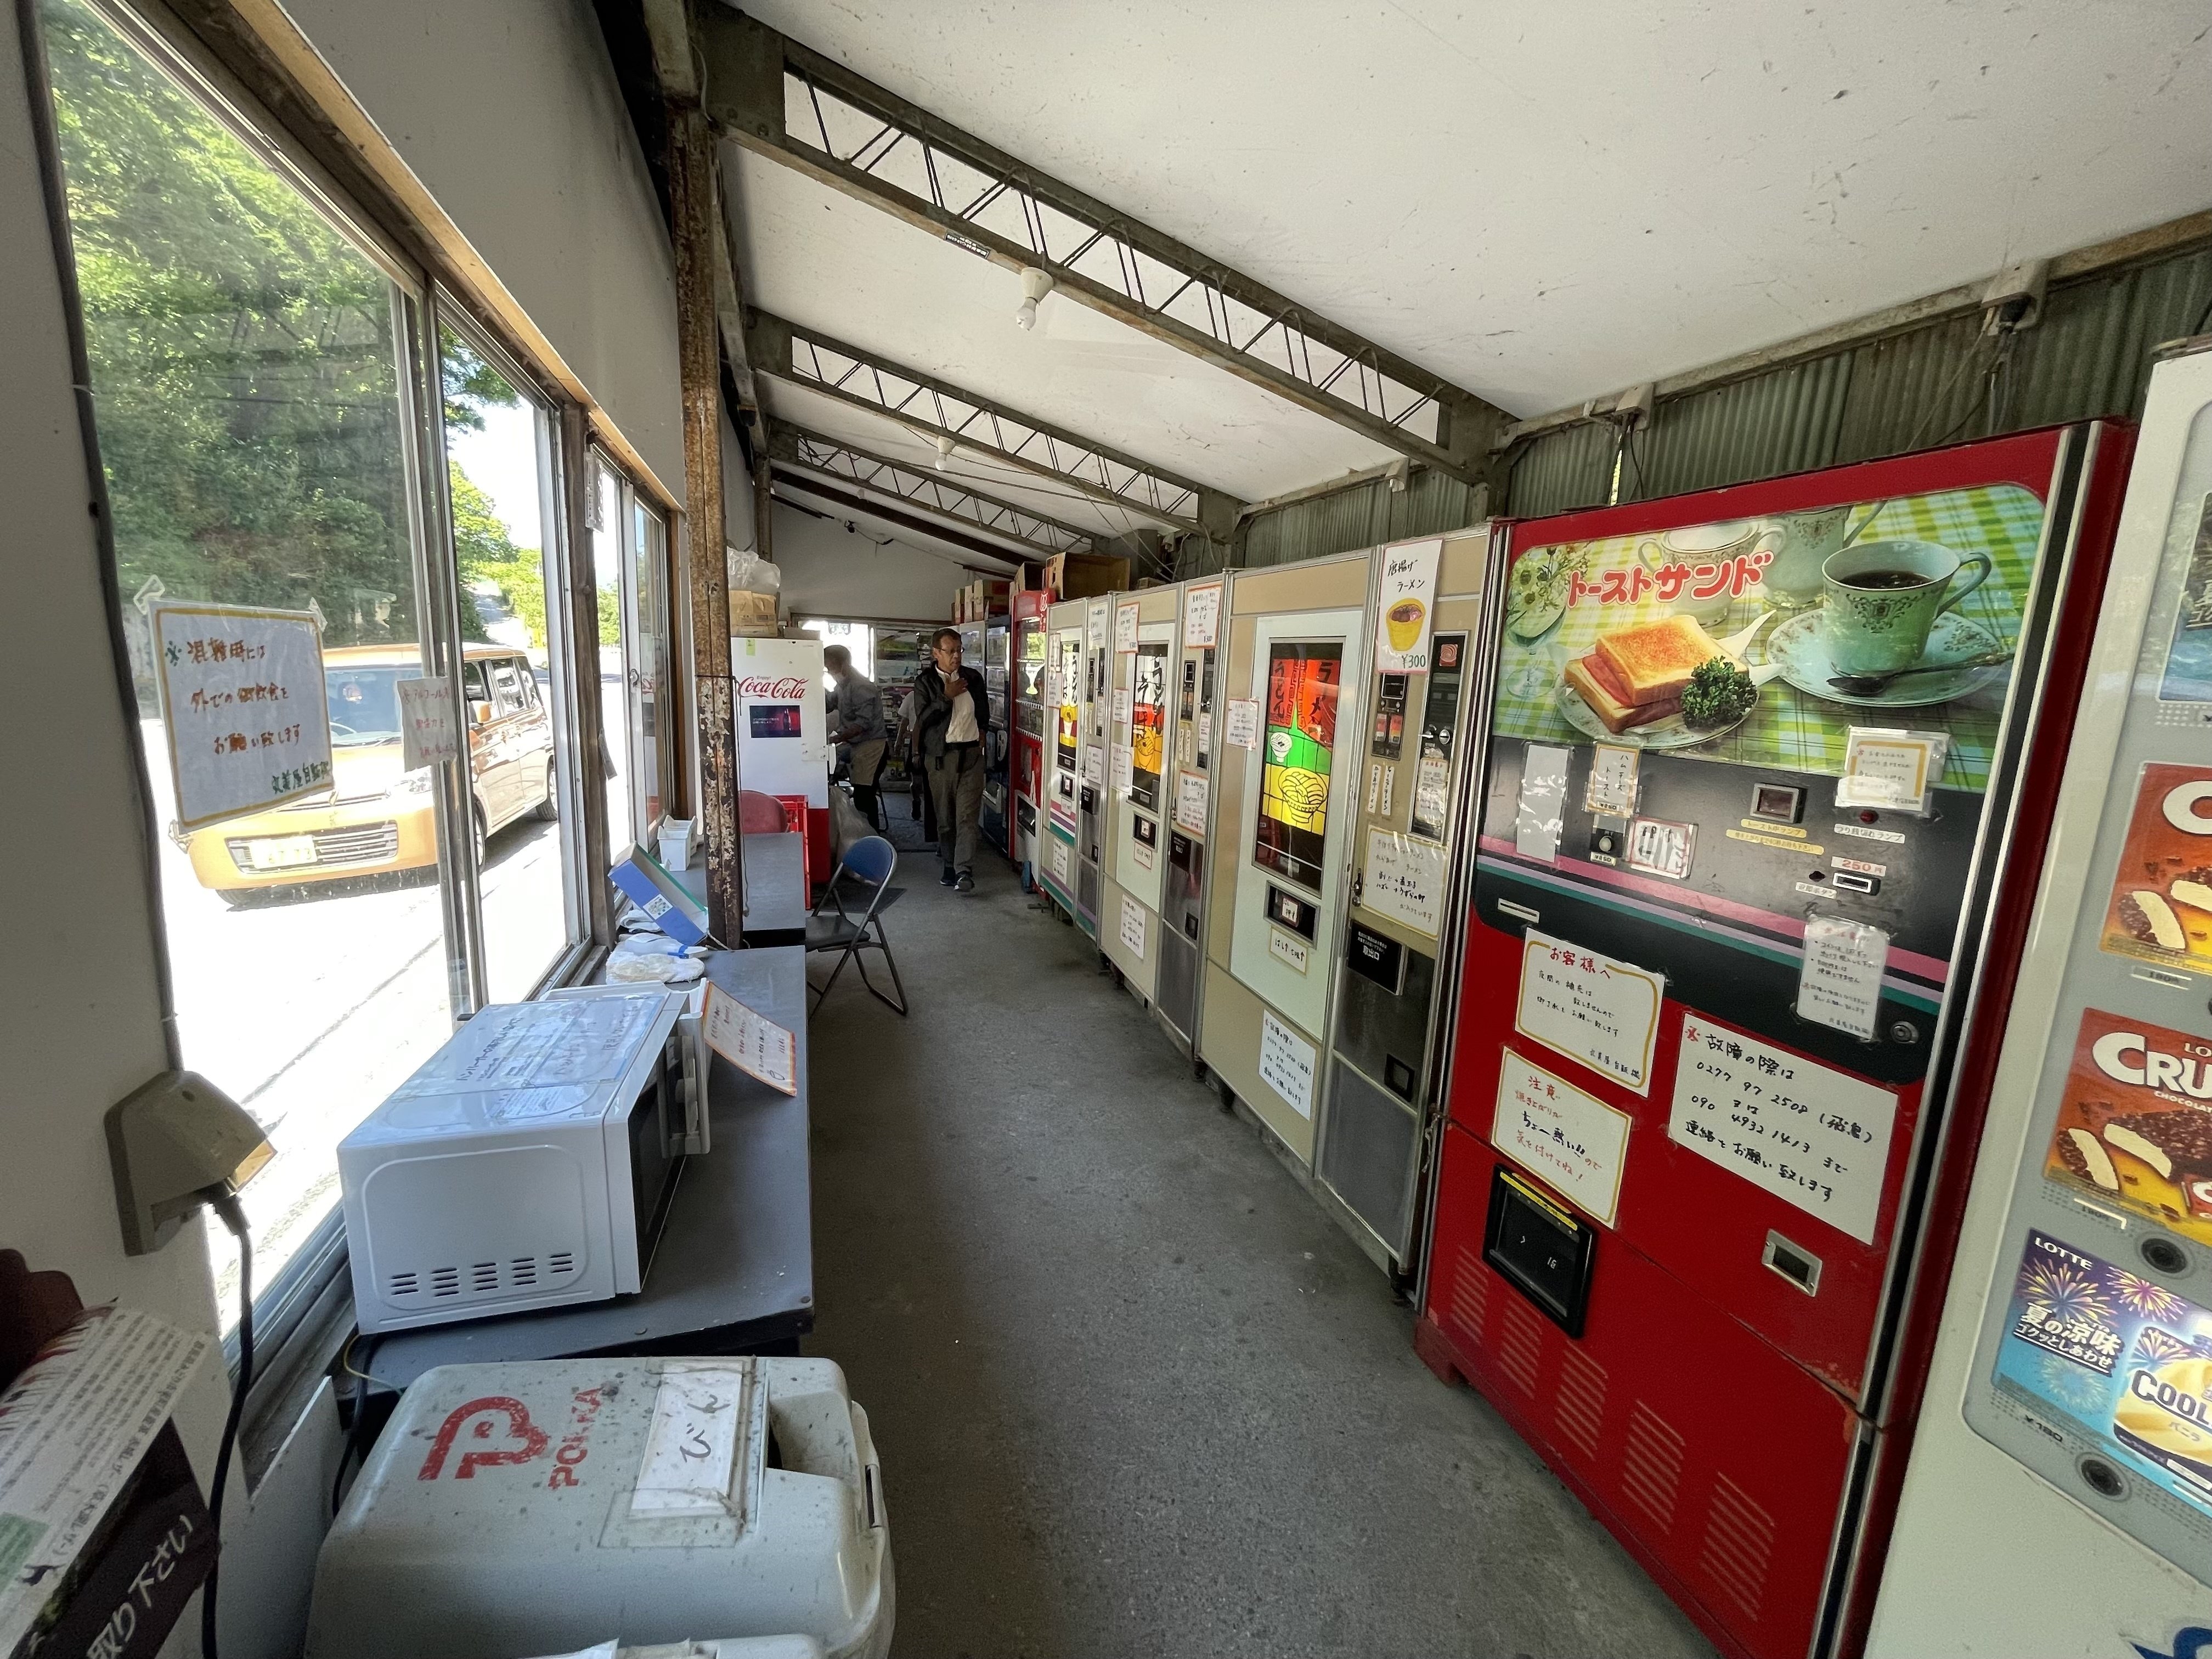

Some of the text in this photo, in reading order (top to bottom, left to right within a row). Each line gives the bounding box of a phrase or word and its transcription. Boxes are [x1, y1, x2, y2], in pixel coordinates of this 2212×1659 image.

[1397, 579, 1425, 593] ラーメン
[1568, 550, 1775, 609] トーストサンド
[1402, 654, 1427, 669] ¥300
[737, 676, 809, 699] Coca-Cola
[1603, 766, 1612, 799] トースト
[1550, 947, 1611, 979] お客様へ
[1706, 1033, 1794, 1080] 故障の際は
[1697, 1062, 1732, 1082] 0277
[1743, 1081, 1763, 1096] 97
[1770, 1094, 1808, 1114] 2508
[1691, 1095, 1716, 1111] 090
[1731, 1114, 1765, 1135] 4932
[1772, 1131, 1810, 1153] 1413
[2034, 1237, 2093, 1271] LOTTE
[2016, 1322, 2113, 1368] コクッとしあわせ
[2021, 1302, 2122, 1357] 夏の涼味
[2024, 1414, 2064, 1443] ¥180
